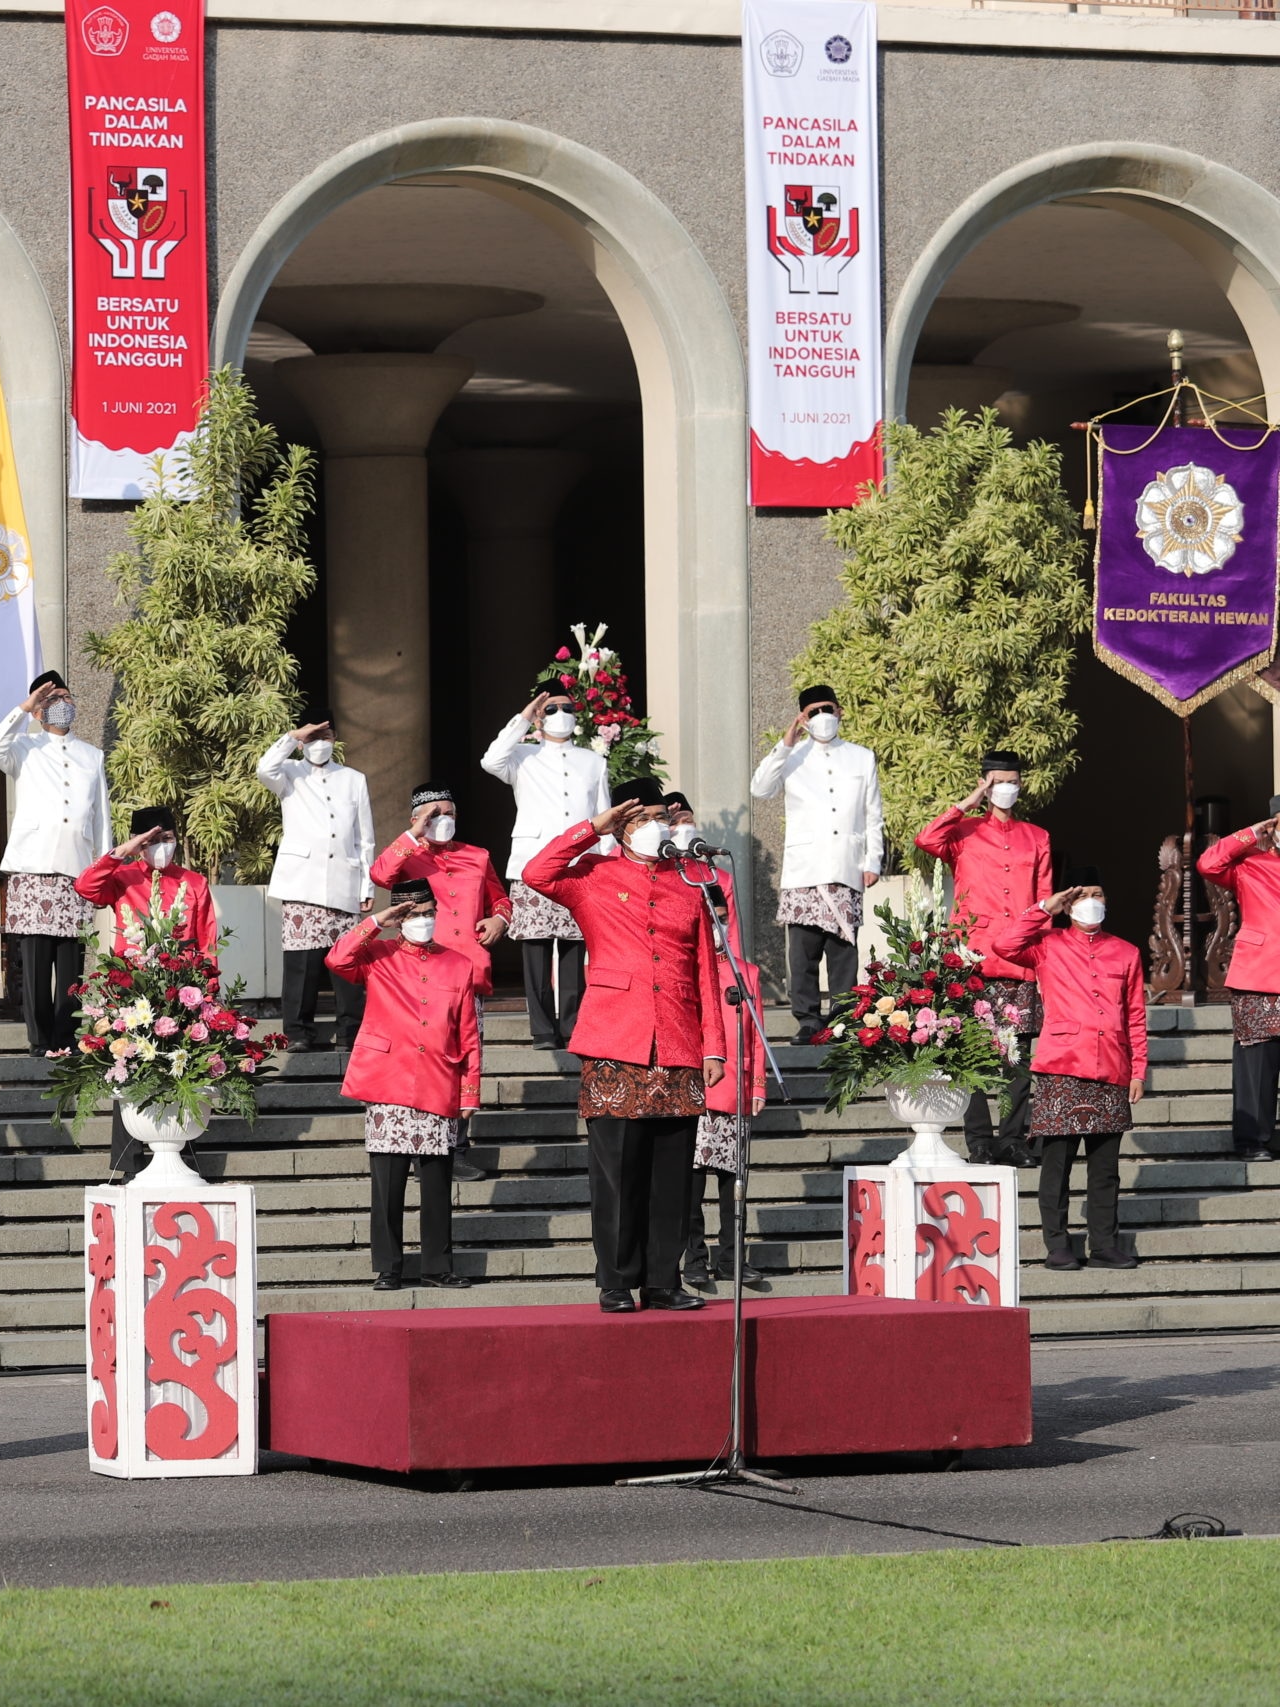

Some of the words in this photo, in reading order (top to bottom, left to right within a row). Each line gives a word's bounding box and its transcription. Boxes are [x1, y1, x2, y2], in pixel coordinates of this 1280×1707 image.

[142, 53, 169, 61] GADJAH
[145, 46, 188, 54] UNIVERSITAS
[84, 95, 188, 113] PANCASILA
[104, 114, 168, 130] DALAM
[762, 116, 858, 132] PANCASILA
[89, 132, 184, 149] TINDAKAN
[782, 134, 840, 149] DALAM
[767, 152, 855, 167] TINDAKAN
[97, 297, 179, 313] BERSATU
[106, 315, 170, 331] UNTUK
[775, 311, 852, 326] BERSATU
[88, 333, 188, 350] INDONESIA
[784, 329, 843, 343] UNTUK
[94, 351, 182, 367] TANGGUH
[769, 346, 861, 361] INDONESIA
[774, 364, 855, 378] TANGGUH
[102, 402, 108, 412] 1
[111, 402, 143, 413] JUNI
[146, 402, 177, 414] 2021
[790, 412, 819, 424] JUNI
[823, 412, 851, 424] 2021
[1149, 592, 1227, 608] FAKULTAS
[1103, 607, 1210, 625] KEDOKTERAN
[1214, 612, 1269, 626] HEWAN
